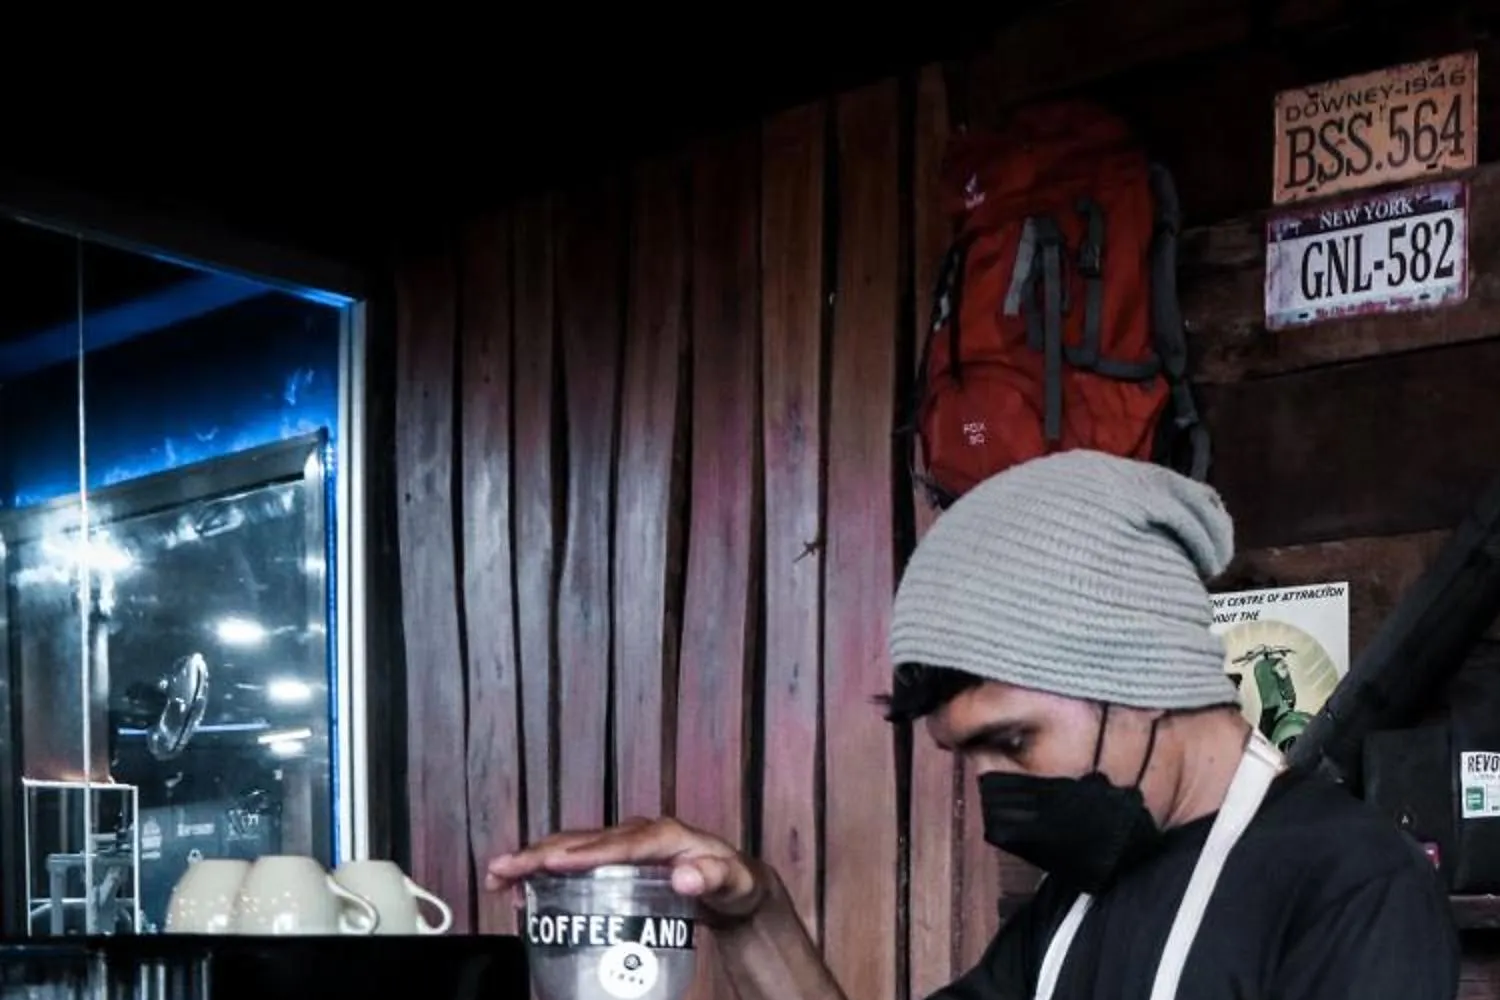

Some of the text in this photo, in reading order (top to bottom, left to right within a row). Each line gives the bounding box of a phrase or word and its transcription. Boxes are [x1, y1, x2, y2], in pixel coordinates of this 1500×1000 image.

[1285, 68, 1467, 123] DOWNEY-1946
[1283, 94, 1466, 189] BSS.564
[1319, 198, 1415, 231] NEW YORK
[1300, 217, 1456, 302] GNL-582
[528, 915, 688, 947] COFFEE AND
